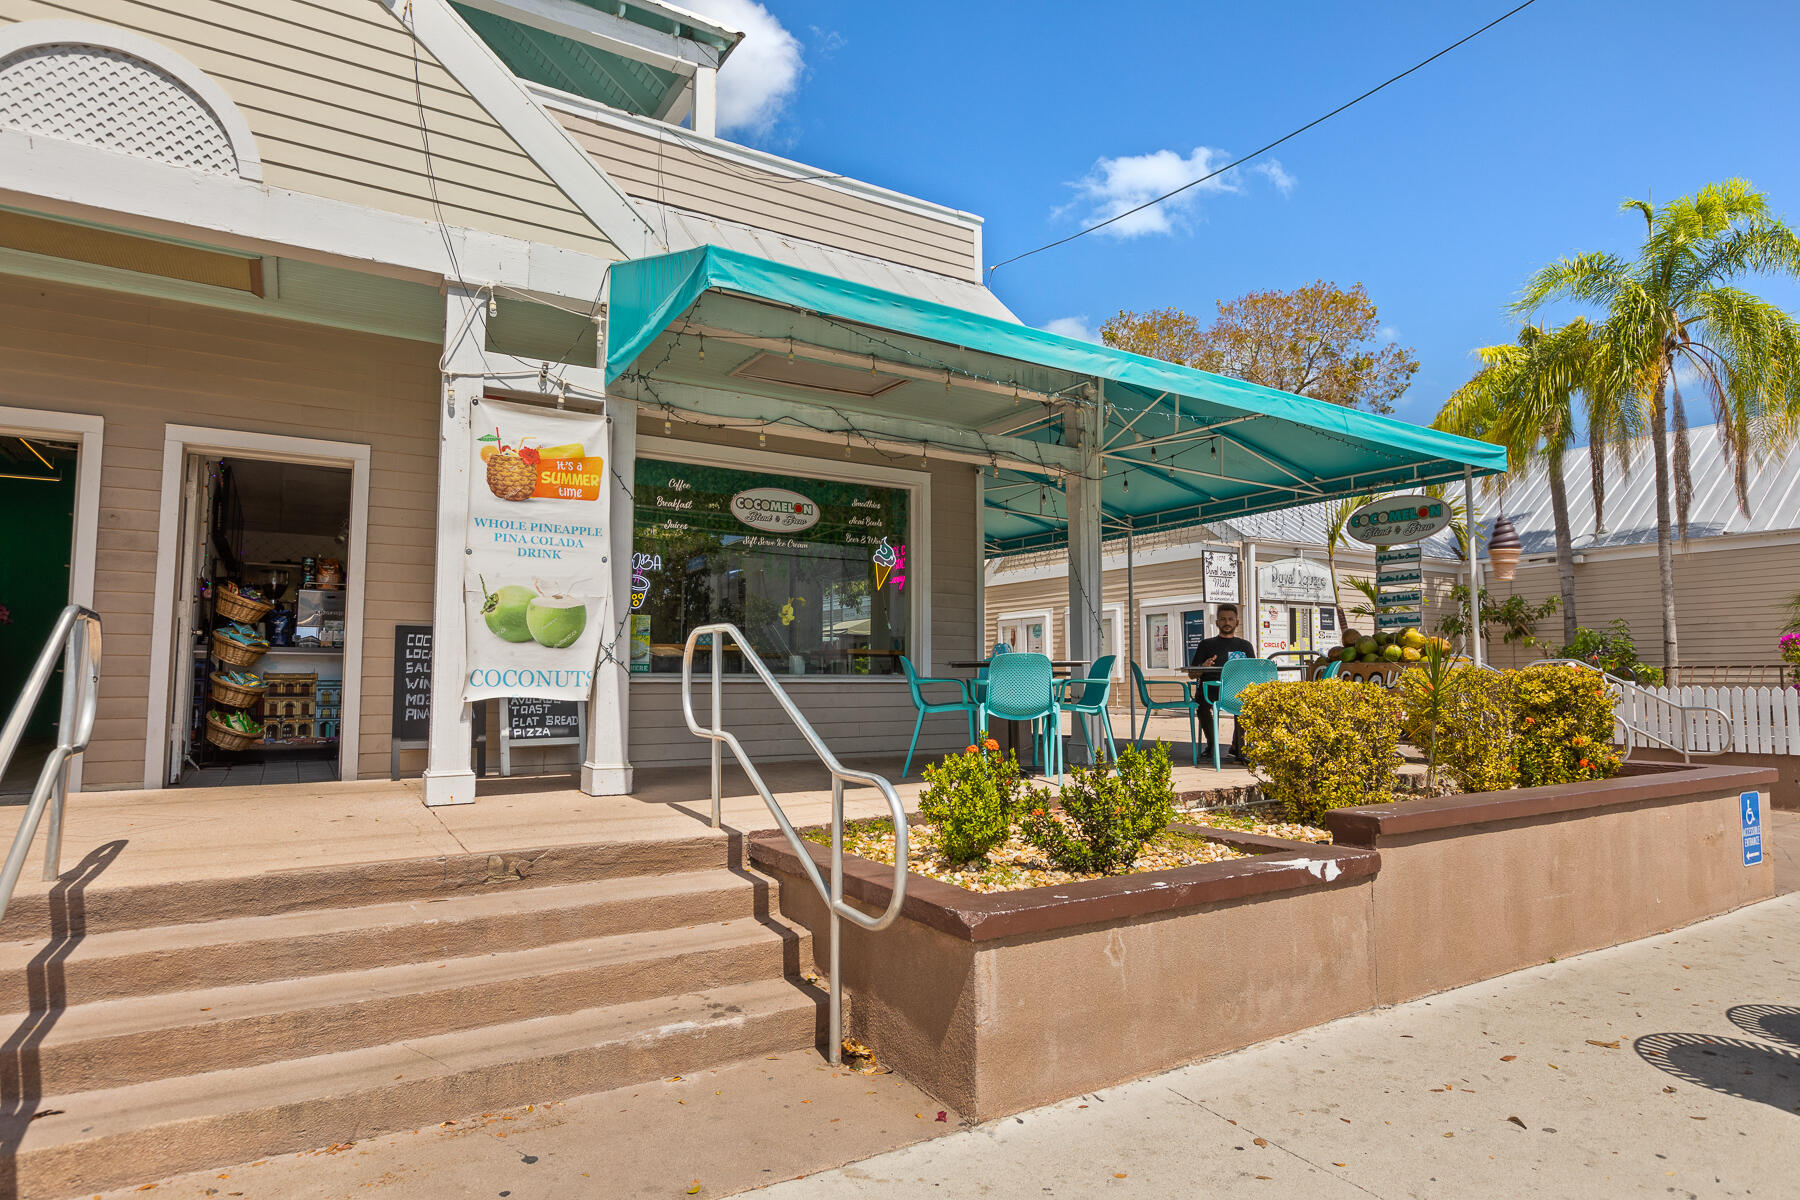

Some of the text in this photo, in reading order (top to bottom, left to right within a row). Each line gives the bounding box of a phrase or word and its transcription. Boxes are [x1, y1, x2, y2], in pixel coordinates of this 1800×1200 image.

[576, 463, 583, 471] a
[541, 471, 600, 487] SUMMER
[668, 478, 691, 491] Coffee
[558, 487, 583, 498] time
[656, 495, 693, 511] Breakfast
[735, 496, 814, 516] COCOMELON
[1351, 503, 1444, 528] COCOMELON
[474, 517, 603, 537] WHOLE PINEAPPLE
[663, 519, 689, 530] Juices
[493, 532, 584, 549] PINA COLADA
[787, 538, 809, 549] Cream
[517, 547, 562, 559] DRINK
[632, 552, 662, 571] OBA
[1271, 565, 1296, 586] Duval
[406, 633, 432, 647] COC
[1280, 641, 1287, 650] K
[405, 662, 433, 674] SAL
[511, 704, 552, 716] TOAST
[512, 715, 579, 728] FLAT BREAD
[513, 728, 551, 739] PIZZA
